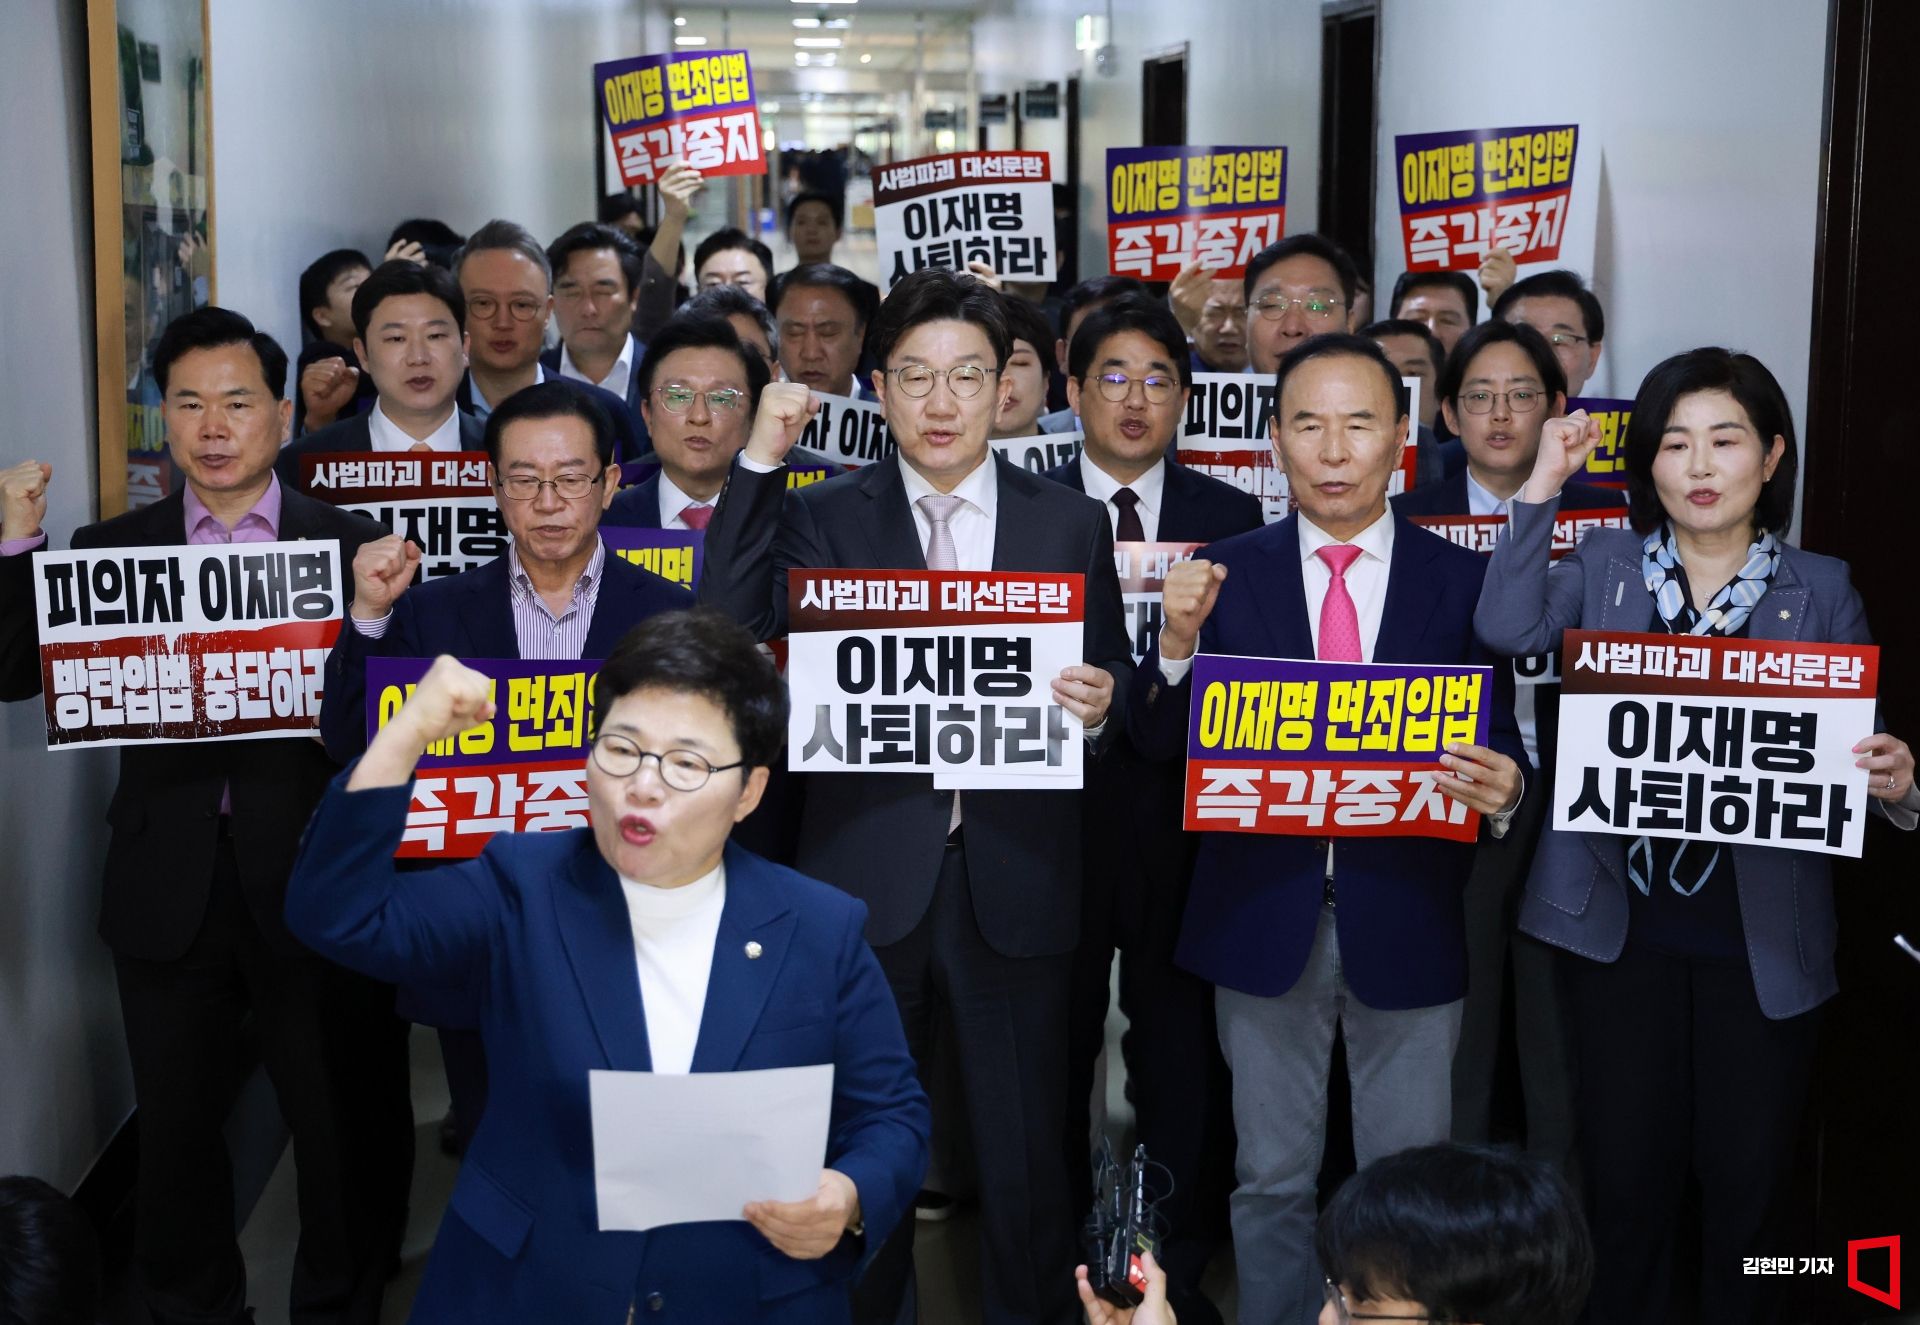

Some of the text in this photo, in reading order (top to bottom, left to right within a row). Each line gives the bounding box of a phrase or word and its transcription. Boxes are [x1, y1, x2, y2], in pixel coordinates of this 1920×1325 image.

[604, 53, 750, 125] 이재명 면죄입법
[618, 112, 759, 180] 즉각중지
[878, 156, 1043, 192] 사법파괴 대선문란
[1402, 128, 1575, 204] 이재명 면죄입법
[1111, 149, 1283, 214] 이재명 면죄입법
[903, 192, 1023, 241] 이재명
[1114, 213, 1279, 276] 즉각중지
[1410, 194, 1567, 267] 즉각중지
[839, 405, 899, 462] 이재
[310, 460, 492, 488] 사법파괴 대선
[44, 551, 333, 628] 피의자 이재명
[800, 579, 1071, 614] 사법파괴 대선문란
[52, 653, 193, 729] 방탄입법
[836, 635, 1032, 697] 이재명
[1574, 641, 1711, 680] 사법파괴
[1722, 651, 1865, 690] 대선문란
[508, 672, 599, 752] 면죄
[802, 703, 1069, 767] 사퇴하라
[1199, 673, 1482, 752] 이재명 면죄입법
[1607, 700, 1818, 774] 이재명
[401, 768, 590, 851] 즉각중
[1196, 767, 1474, 827] 즉각중지
[1568, 766, 1852, 848] 사퇴하라
